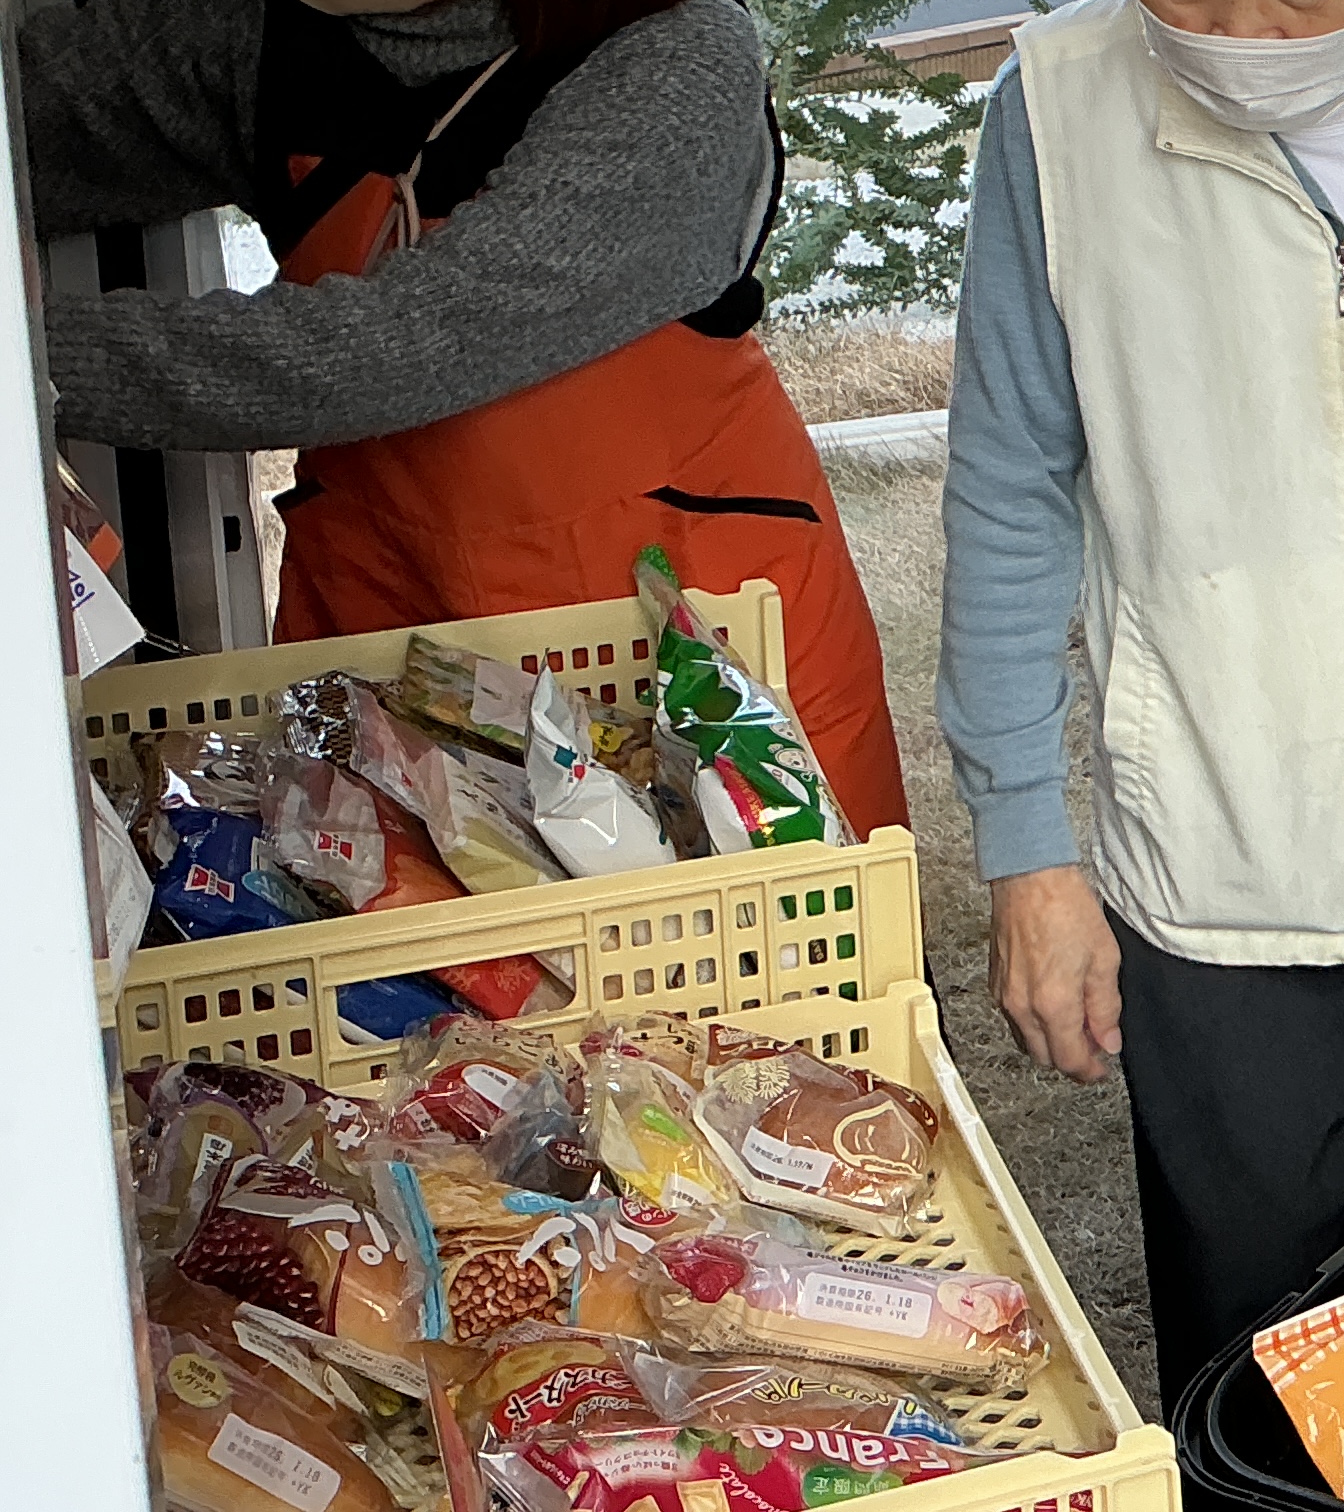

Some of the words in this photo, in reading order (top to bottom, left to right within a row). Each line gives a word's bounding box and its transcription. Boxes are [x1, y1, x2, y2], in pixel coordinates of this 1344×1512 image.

[753, 1425, 951, 1471] France
[812, 1474, 890, 1496] 期間限定
